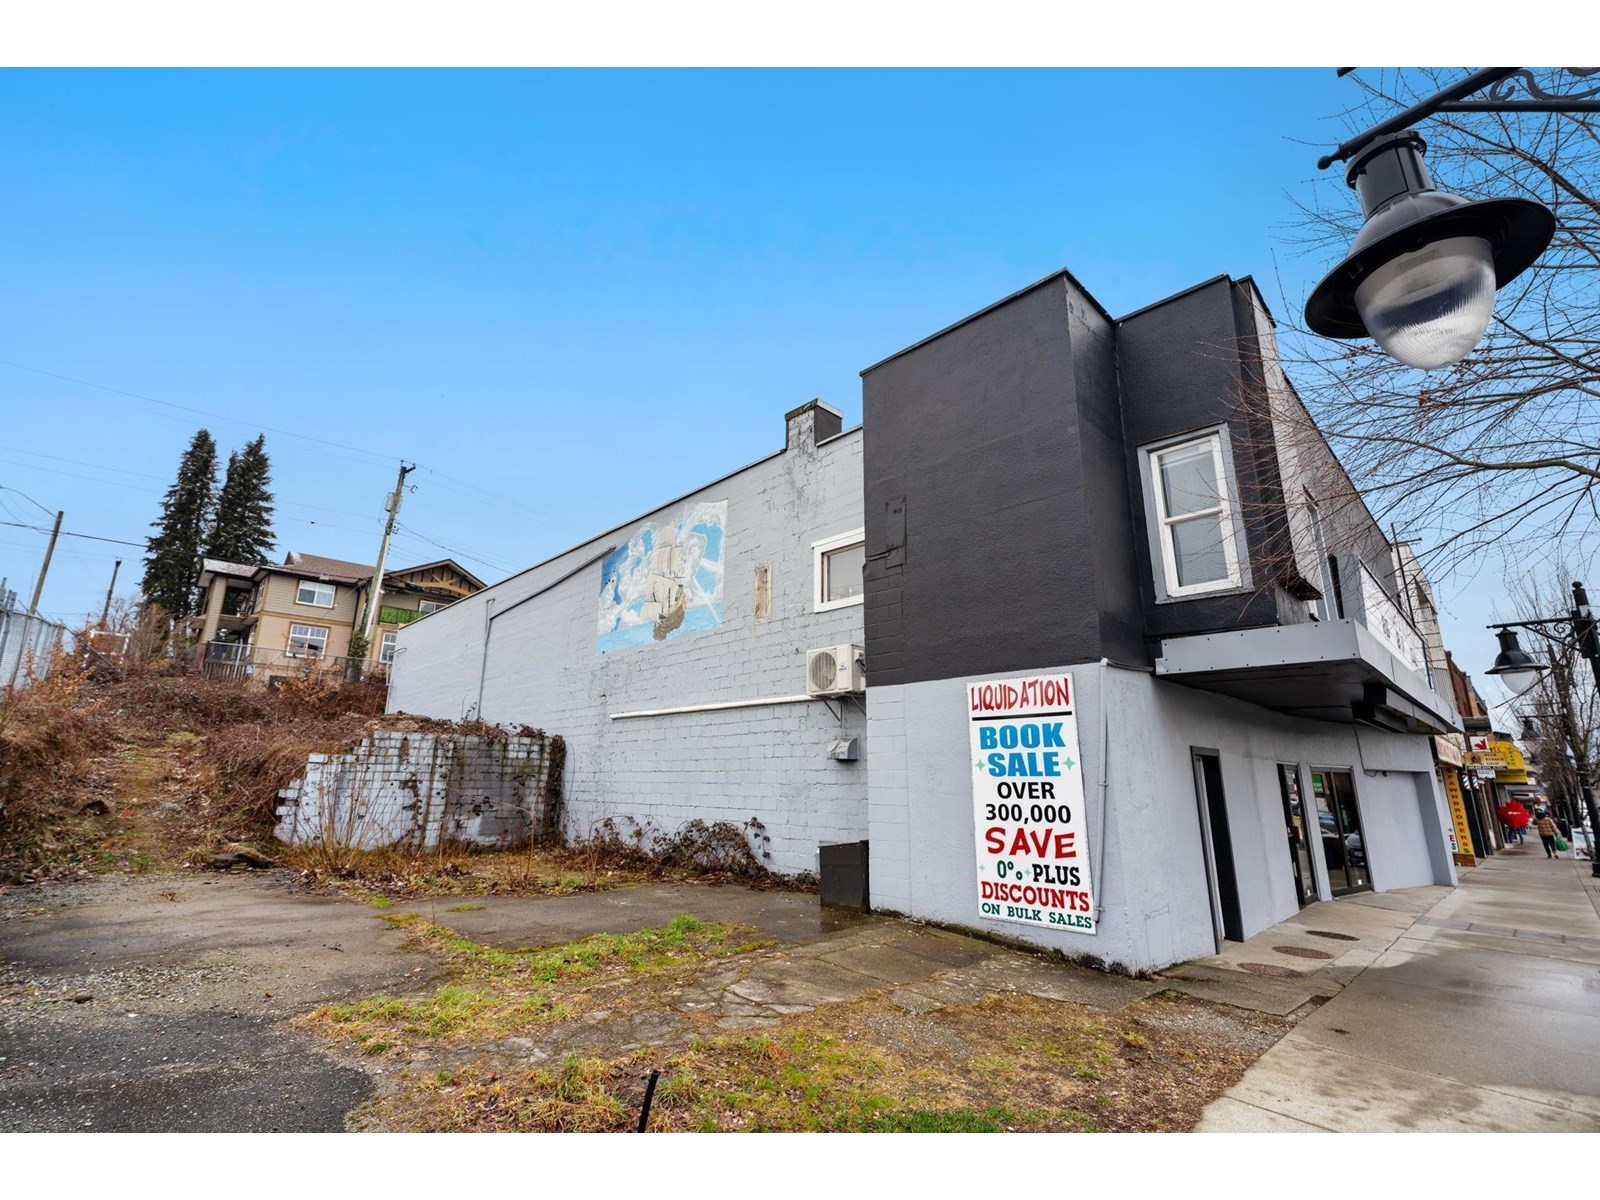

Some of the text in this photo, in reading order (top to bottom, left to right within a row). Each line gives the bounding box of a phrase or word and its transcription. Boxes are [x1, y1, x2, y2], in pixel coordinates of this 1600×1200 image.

[971, 677, 1069, 712] LIQUIDATION
[979, 722, 1066, 750] BOOK
[987, 751, 1061, 777] SALE
[997, 781, 1056, 800] OVER
[985, 803, 1071, 824] 300,000
[1447, 774, 1469, 847] PAWNBROKERS
[985, 826, 1077, 859] SAVE
[1032, 863, 1081, 887] PLUS
[981, 881, 1090, 913] DISCOUNTS
[981, 902, 1093, 930] ON BULK SALES
